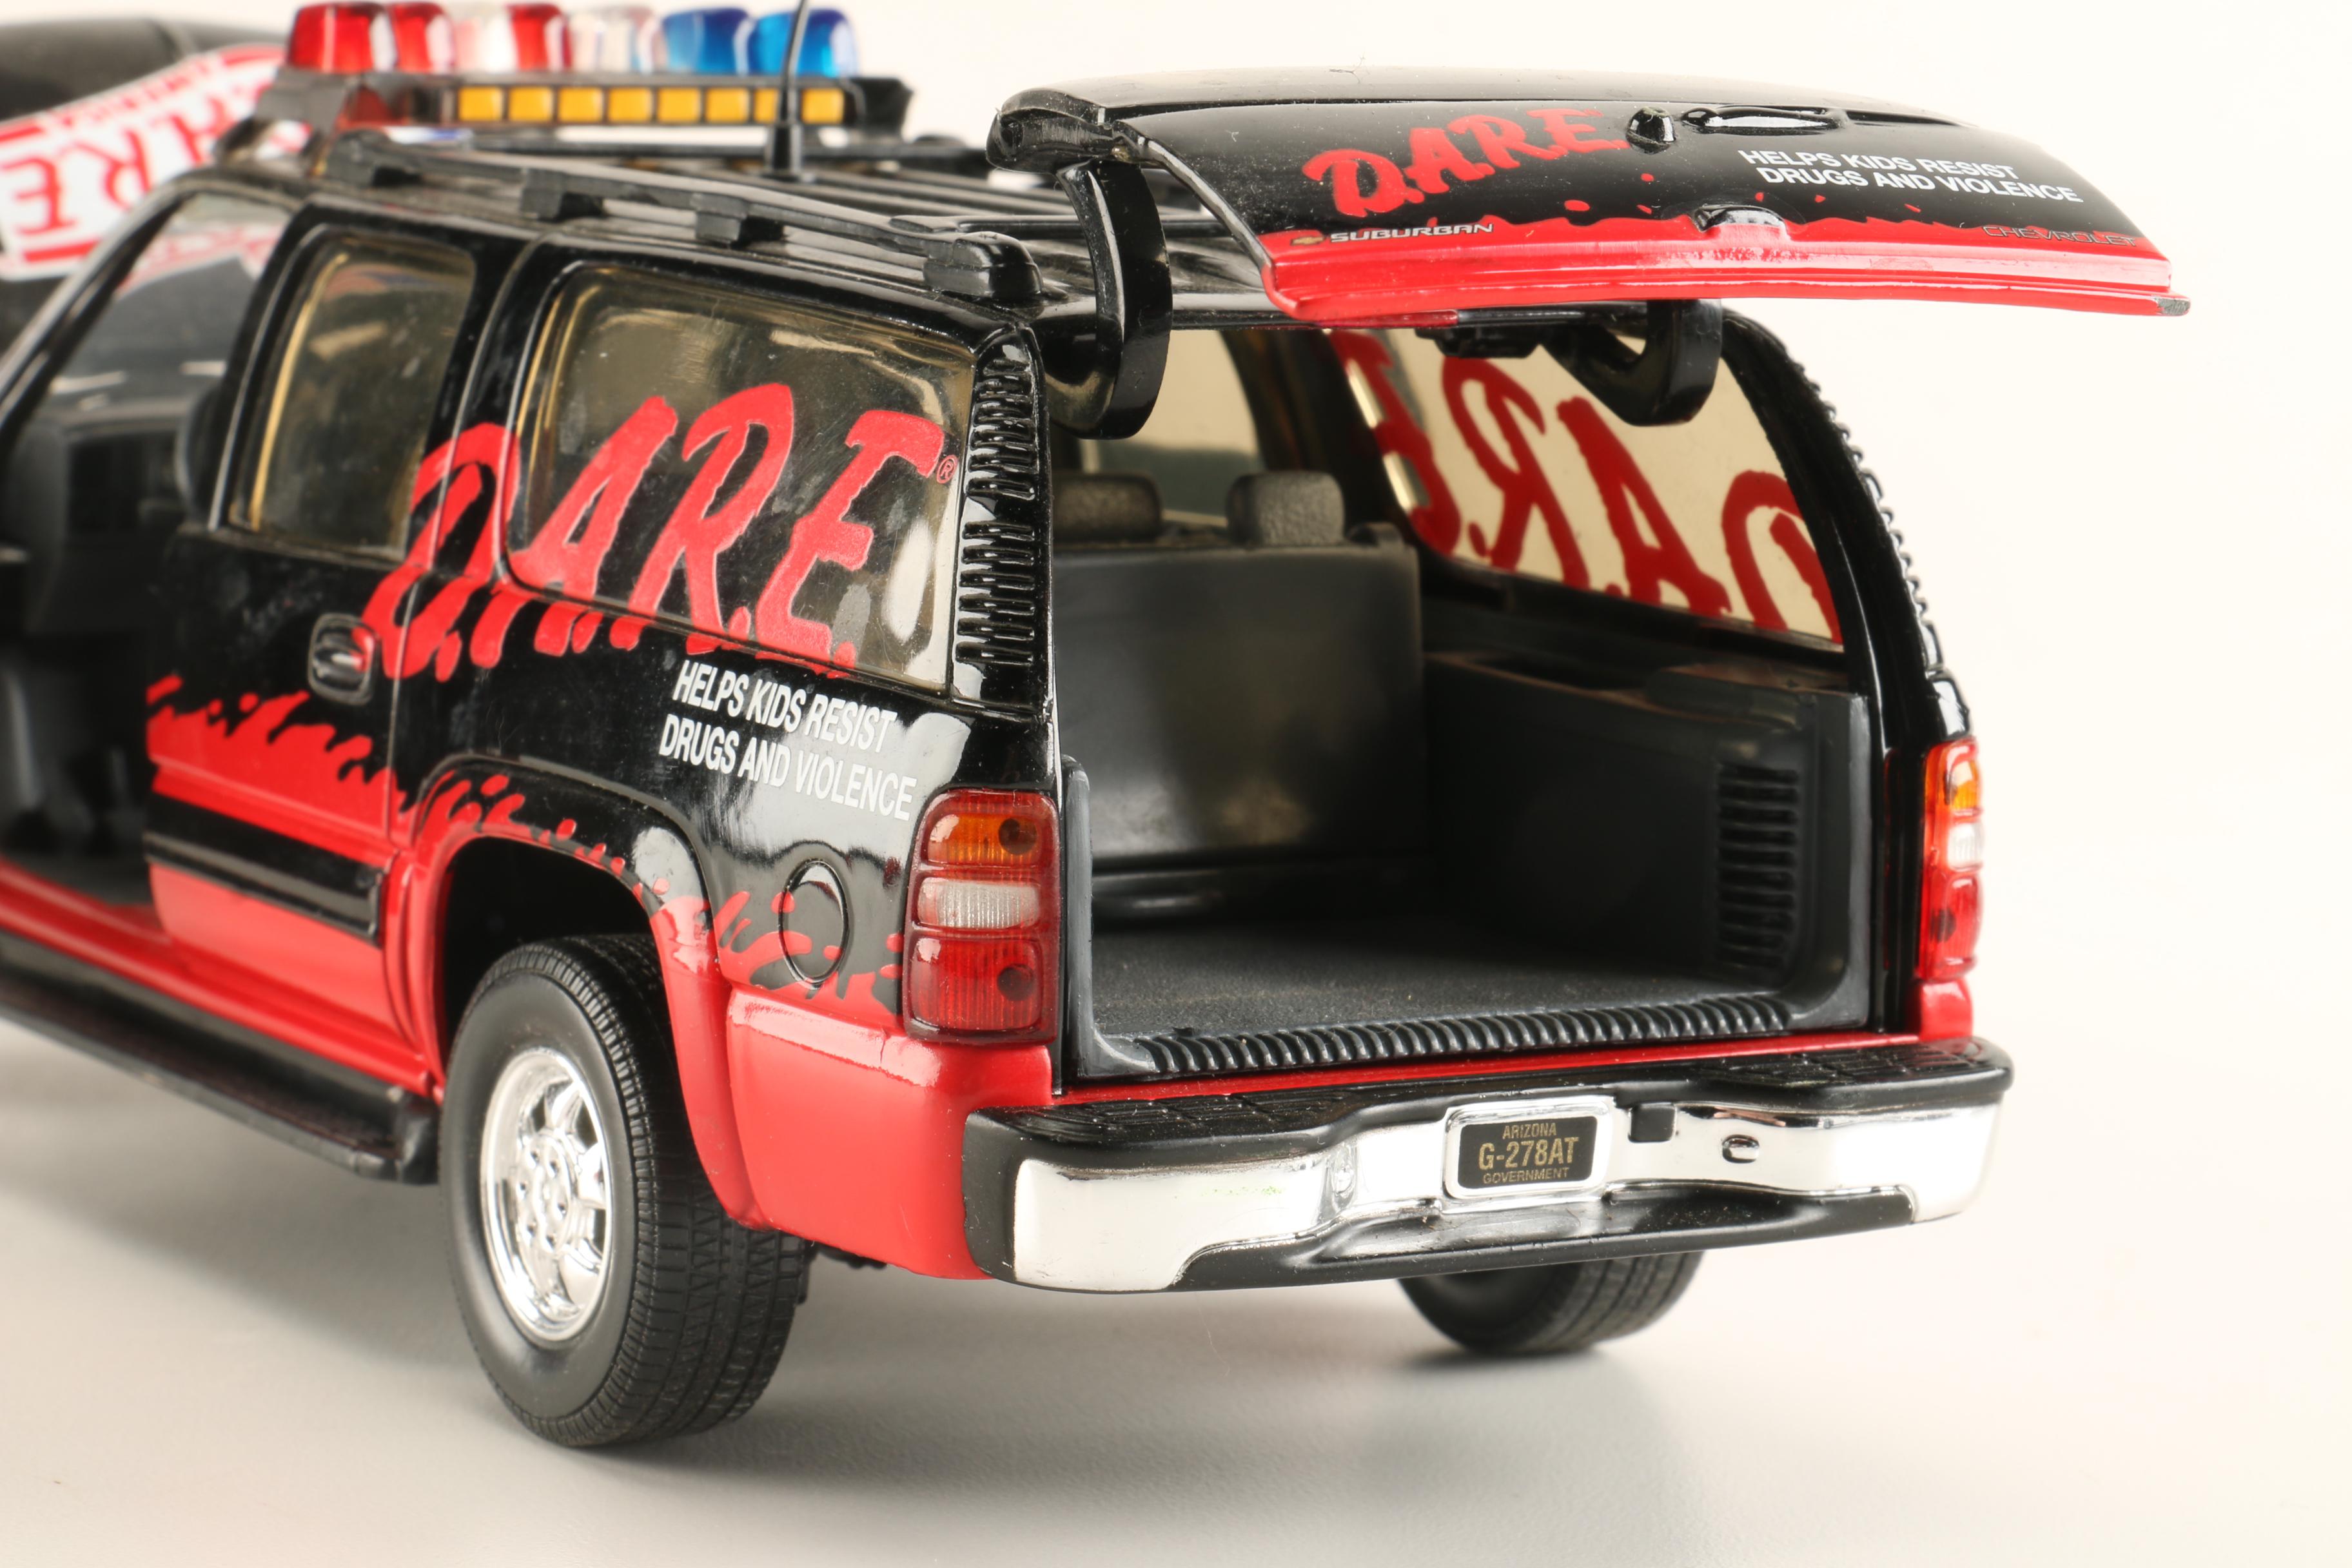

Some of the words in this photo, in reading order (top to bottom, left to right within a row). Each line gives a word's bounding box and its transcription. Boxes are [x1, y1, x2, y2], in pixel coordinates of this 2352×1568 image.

[1738, 150, 1842, 168] HELPS
[1841, 153, 1918, 172] KIDS
[1916, 158, 2020, 180] RESIST
[1756, 166, 1868, 187] DRUGS
[1873, 172, 1936, 191] AND
[1934, 175, 2084, 203] VIOLENCE
[1330, 223, 1493, 243] SUBURBAN
[1983, 226, 2137, 246] CHEVROLET
[672, 660, 749, 718] HELPS
[746, 678, 807, 733] KIDS
[805, 693, 898, 753] RESIST
[658, 713, 740, 774] DRUGS
[737, 737, 792, 788] AND
[795, 749, 917, 821] VIOLENCE
[1502, 1122, 1557, 1140] ARIZONA
[1478, 1136, 1579, 1170] G-278AT
[1483, 1166, 1570, 1184] GOVERNMENT
